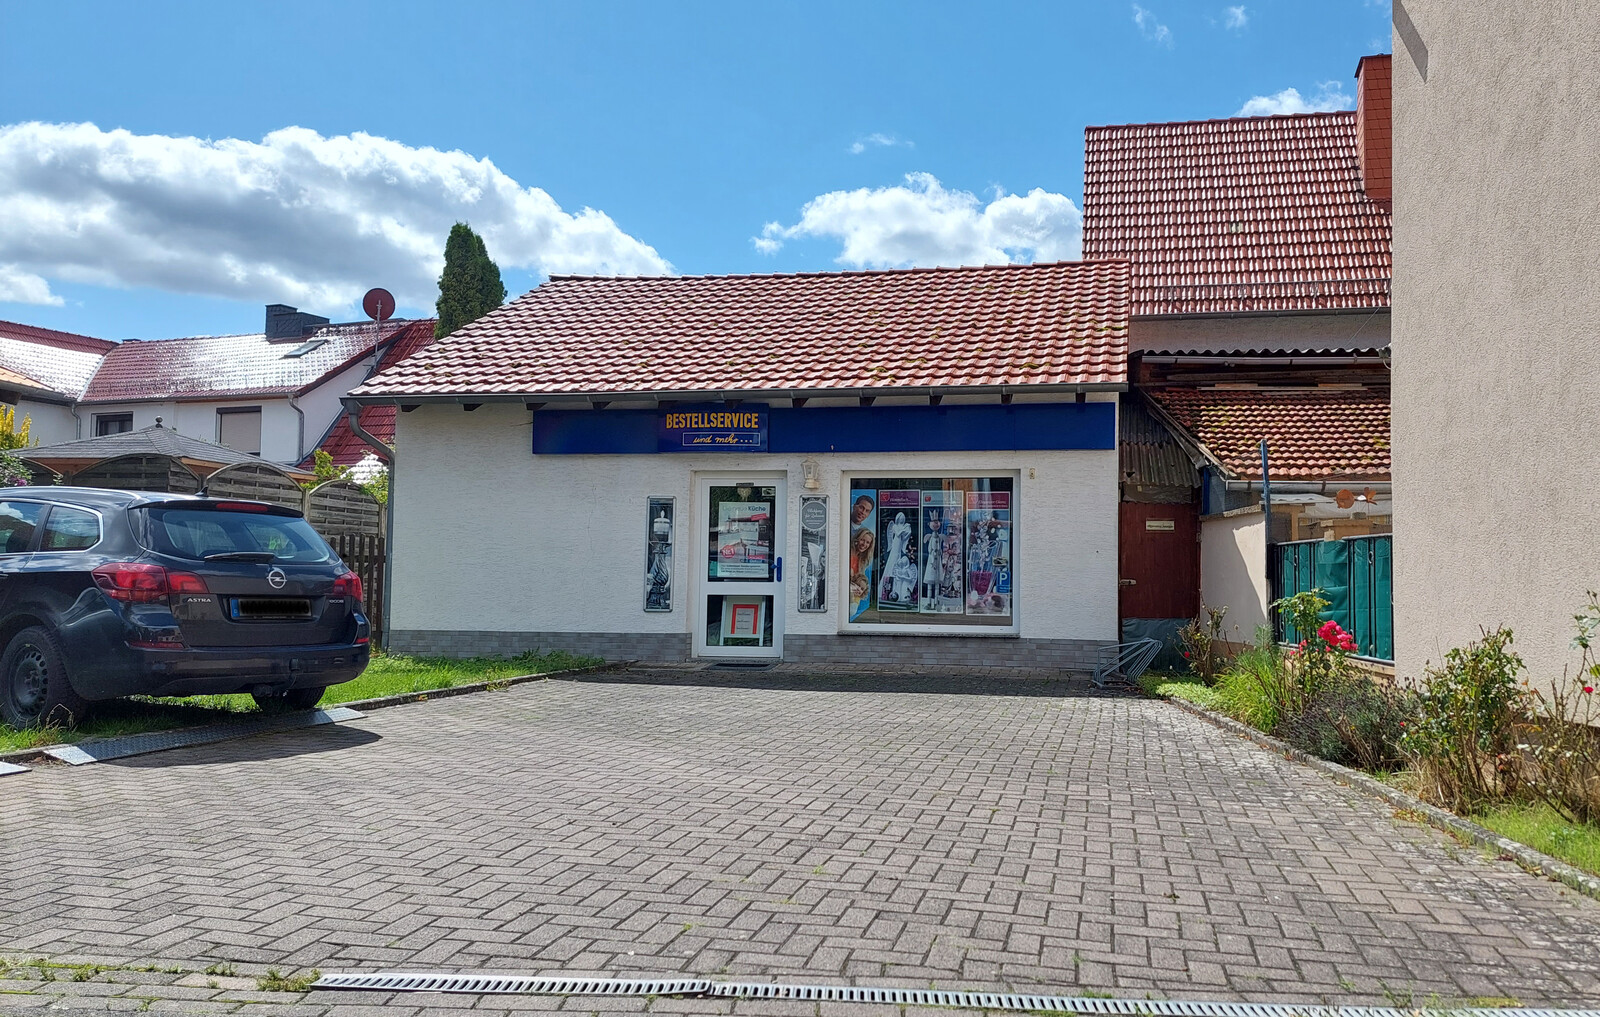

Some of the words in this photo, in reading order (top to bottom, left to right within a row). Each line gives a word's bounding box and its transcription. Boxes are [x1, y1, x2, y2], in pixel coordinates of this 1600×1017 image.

[666, 413, 758, 428] BESTELLSERVICE
[693, 434, 712, 444] und
[999, 572, 1007, 584] P
